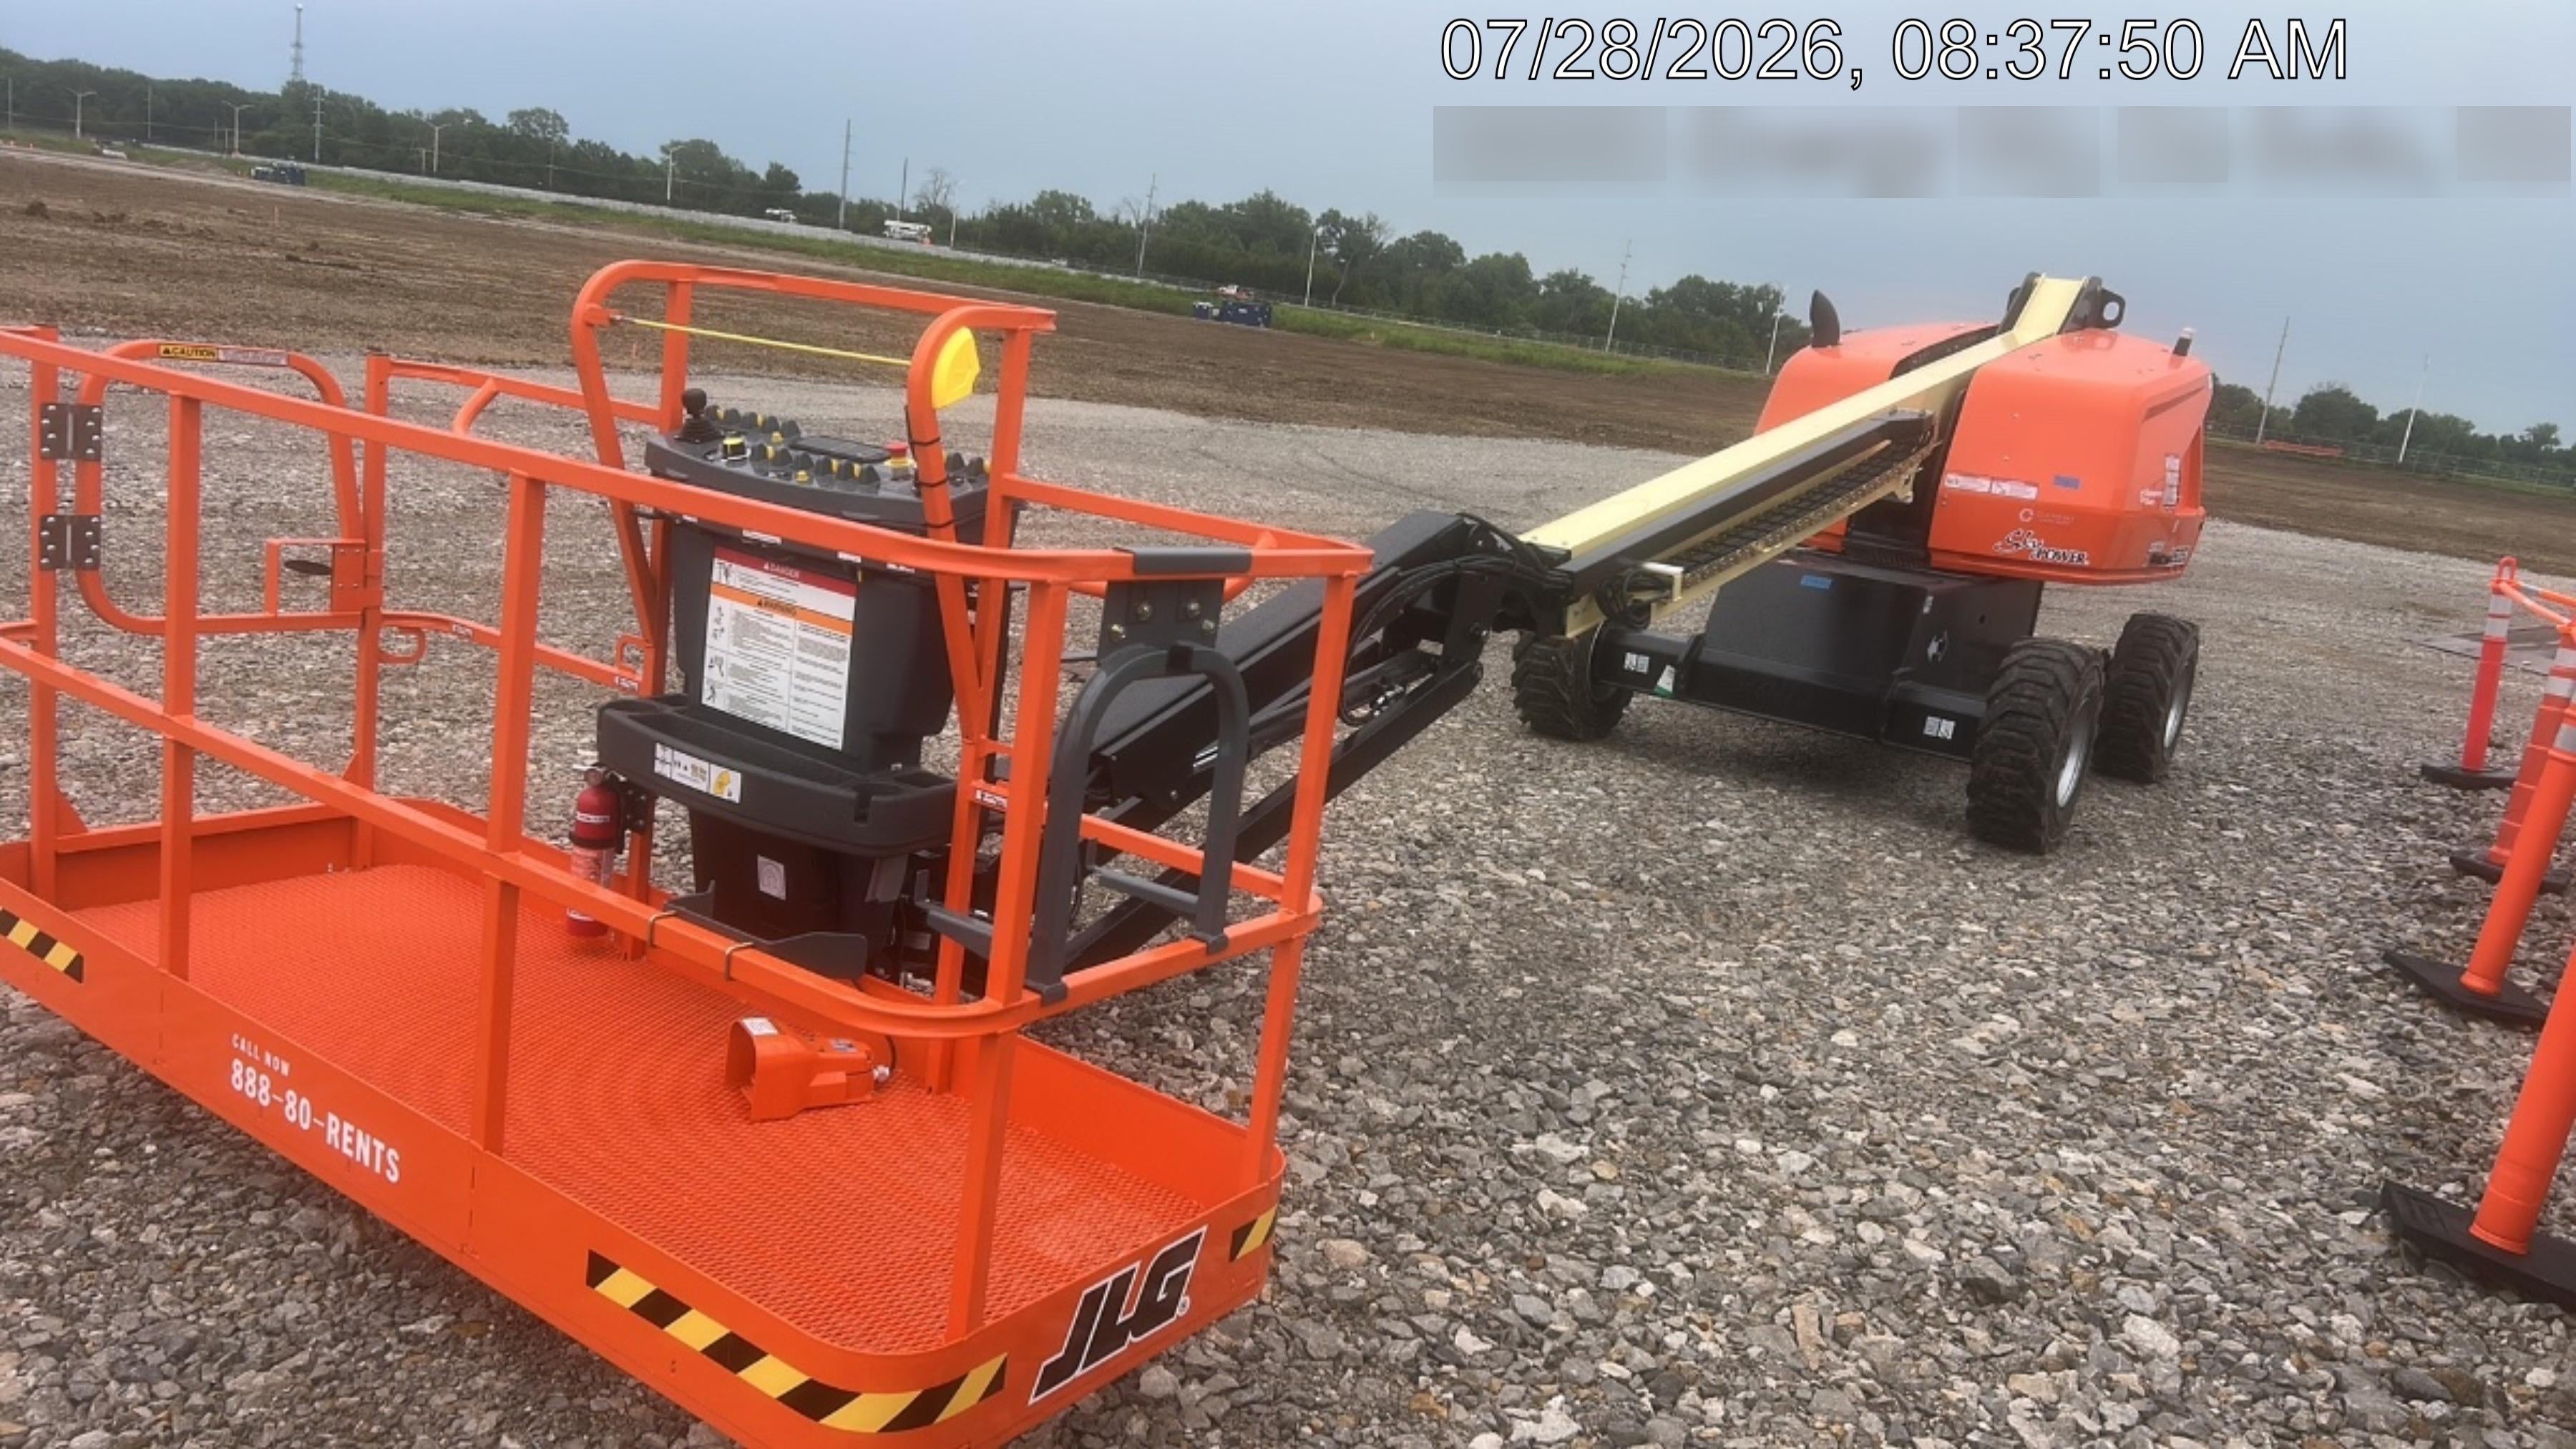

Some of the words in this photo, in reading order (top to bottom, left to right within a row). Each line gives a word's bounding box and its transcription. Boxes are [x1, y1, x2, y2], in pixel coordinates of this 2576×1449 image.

[170, 348, 215, 358] CAUTION
[231, 1033, 260, 1060] CALL
[264, 1050, 291, 1077] NOW
[231, 1058, 400, 1184] 888-80-RENTS
[1028, 1224, 1209, 1407] JLG
